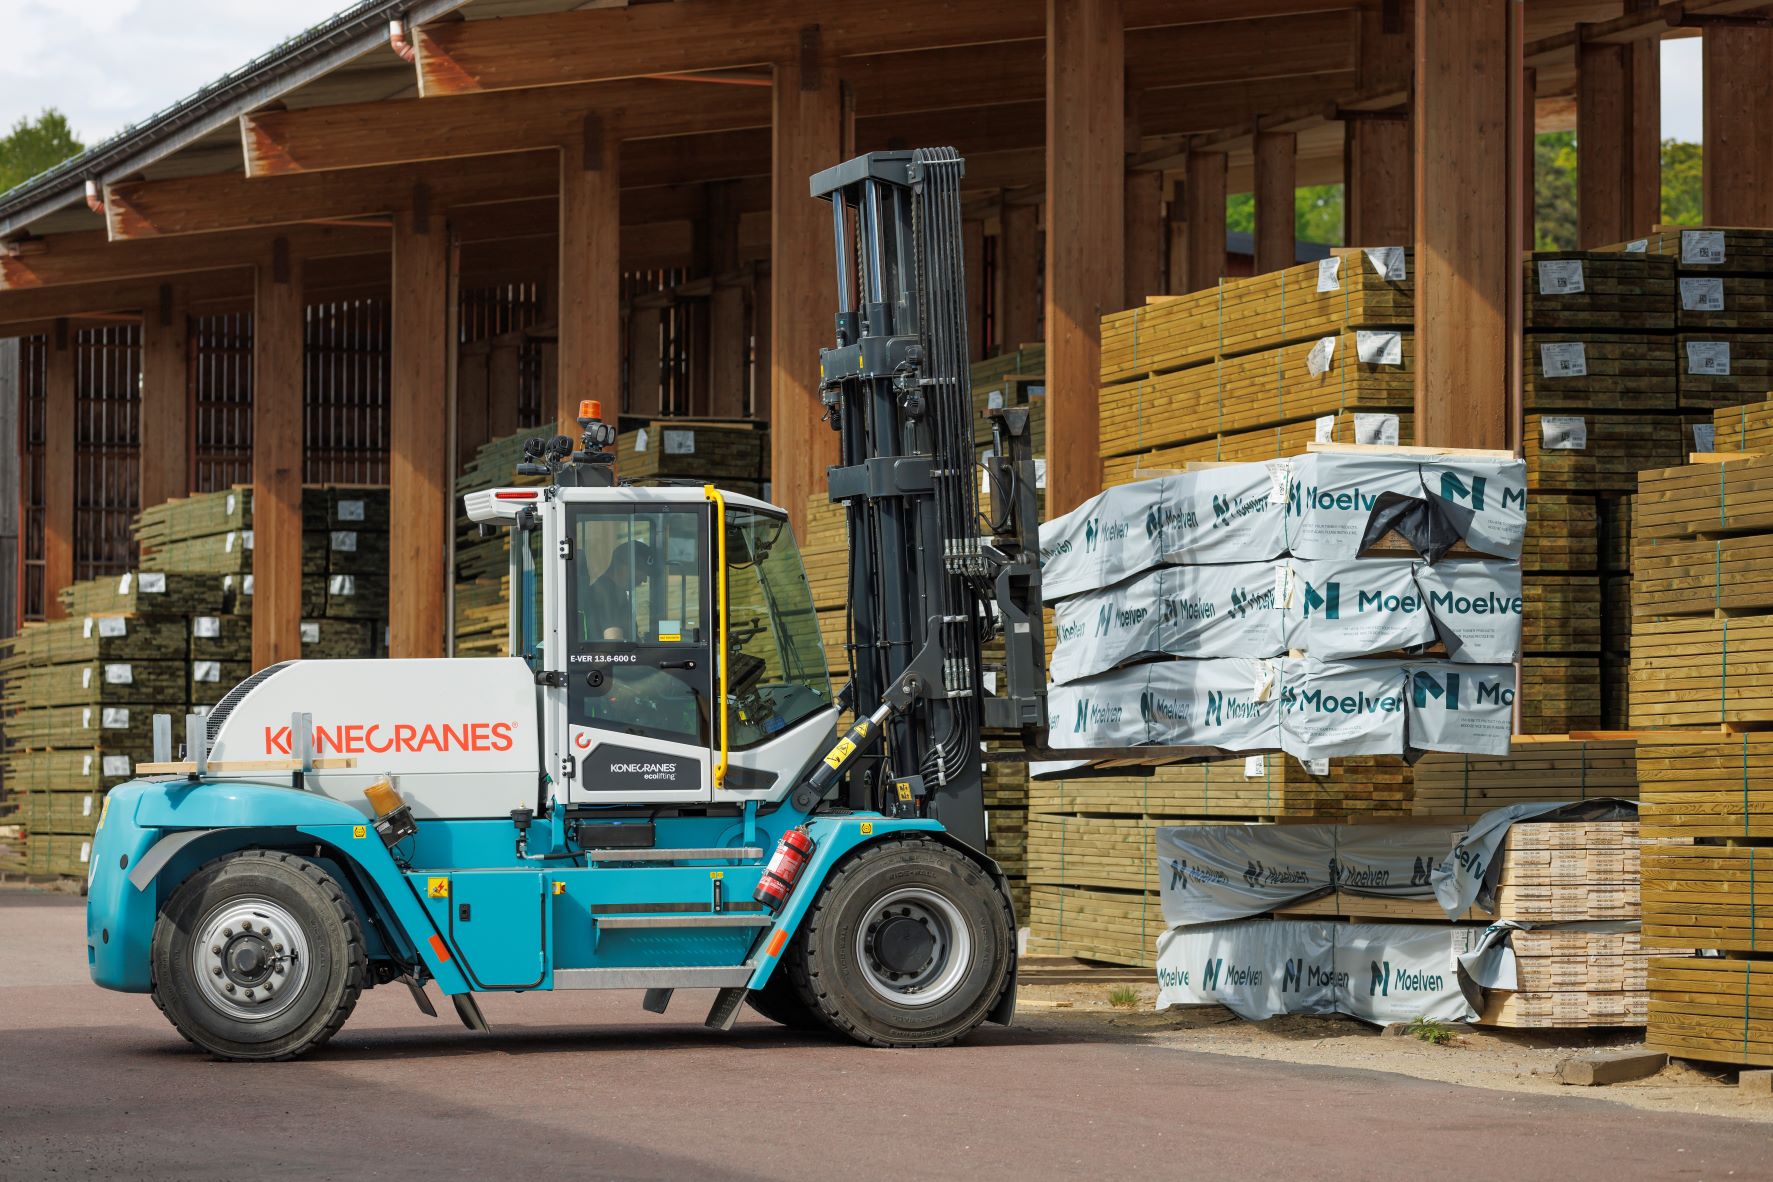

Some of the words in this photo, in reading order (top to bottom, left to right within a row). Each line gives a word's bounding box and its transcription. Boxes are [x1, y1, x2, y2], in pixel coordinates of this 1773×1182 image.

[1165, 508, 1199, 529] Moelven
[1102, 520, 1129, 544] Moelven
[1115, 608, 1148, 628] Moelven
[1180, 598, 1216, 619] Moelven
[570, 655, 593, 663] E-VER
[594, 655, 629, 663] 13.6-600
[630, 655, 637, 663] C
[1091, 703, 1123, 724] Moelven
[1157, 698, 1191, 720] Moelven
[610, 763, 676, 773] KONECRANES
[643, 773, 675, 781] ecolifting
[1265, 865, 1310, 885] Moelven
[1345, 865, 1390, 887] Moelven
[1225, 964, 1263, 987] Moelven
[1394, 968, 1444, 992] Moelven
